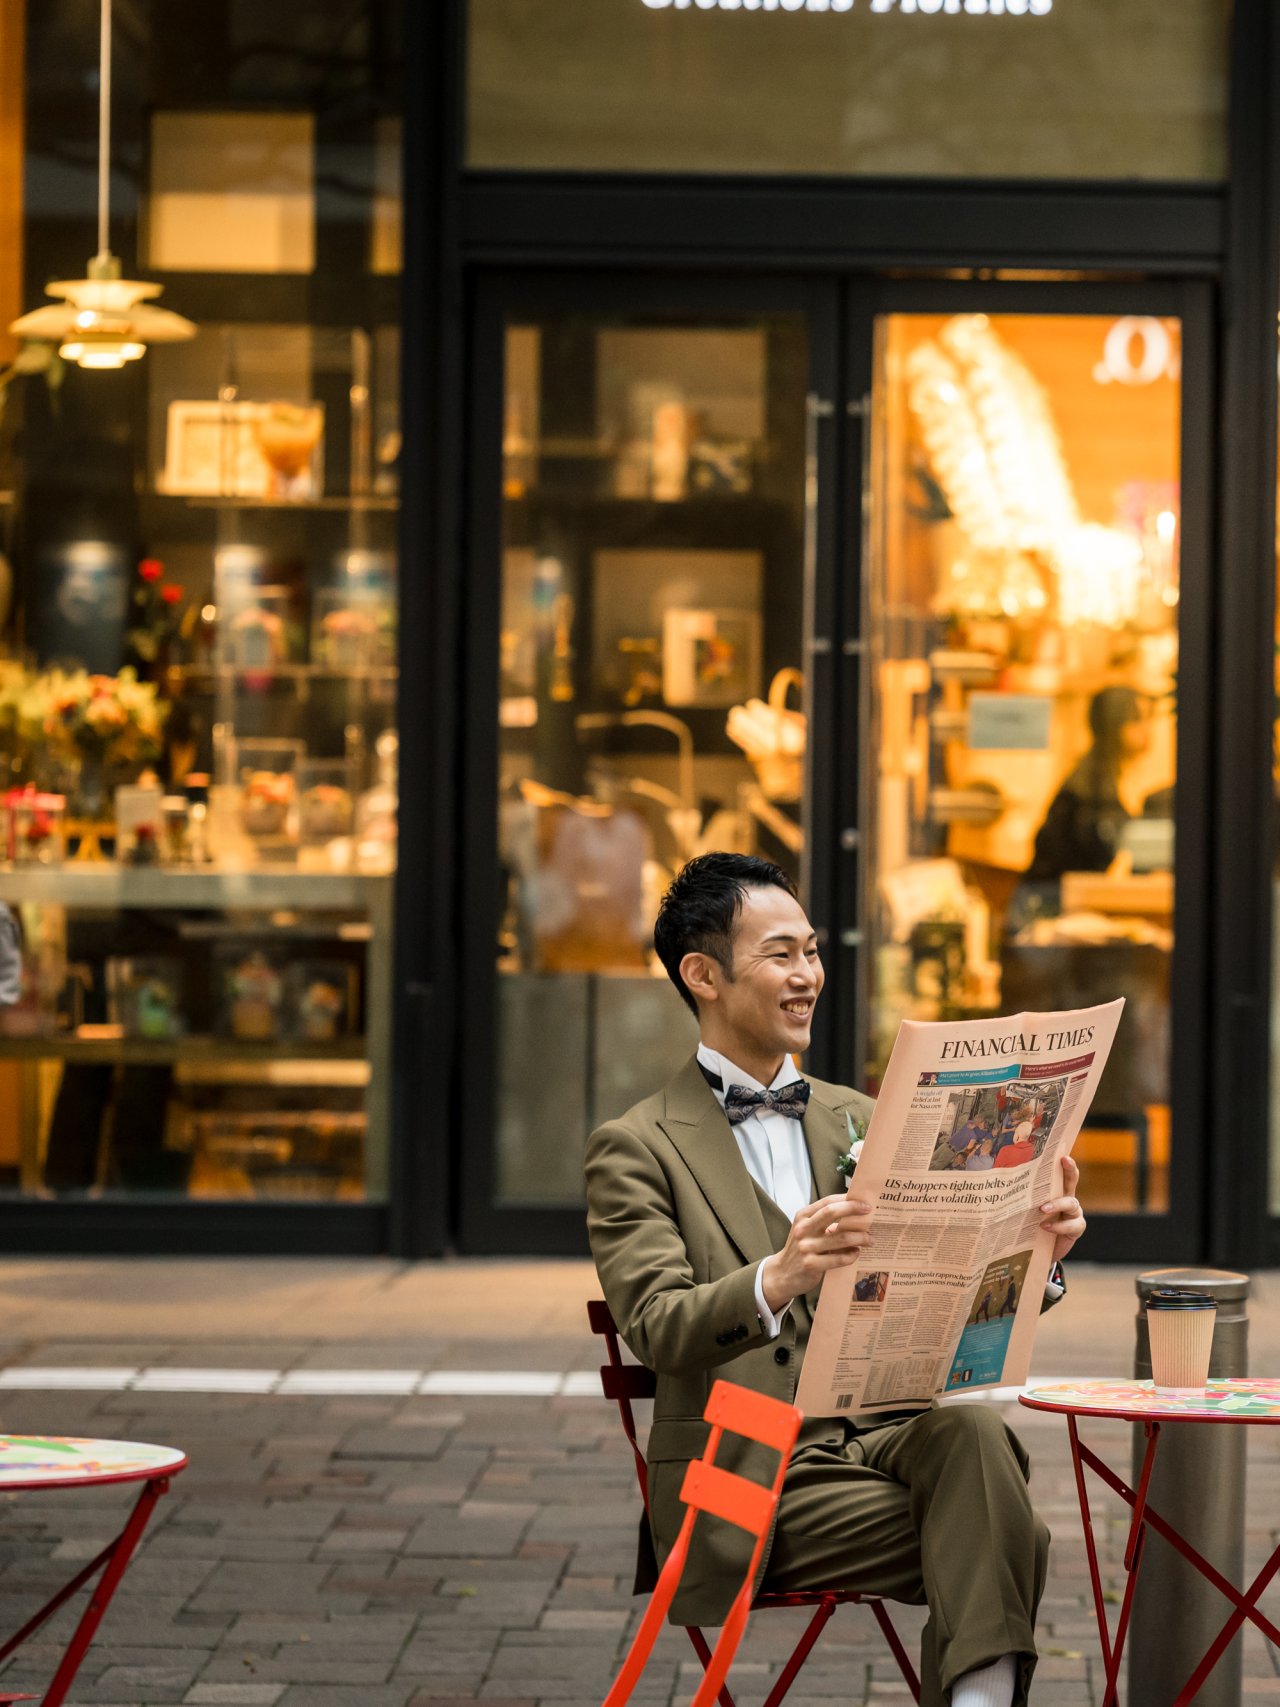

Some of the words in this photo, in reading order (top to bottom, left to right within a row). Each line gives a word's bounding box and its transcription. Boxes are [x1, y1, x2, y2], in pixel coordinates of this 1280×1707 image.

[940, 1033, 1040, 1059] FINANCIAL
[1046, 1025, 1095, 1051] TIMES
[884, 1178, 902, 1189] US
[902, 1179, 948, 1193] shoppers
[949, 1180, 985, 1193] tighten
[984, 1177, 1006, 1190] belts
[879, 1191, 901, 1202] and
[901, 1192, 938, 1203] market
[941, 1193, 984, 1207] volatility
[984, 1193, 1000, 1205] sap
[893, 1271, 917, 1279] Trump's
